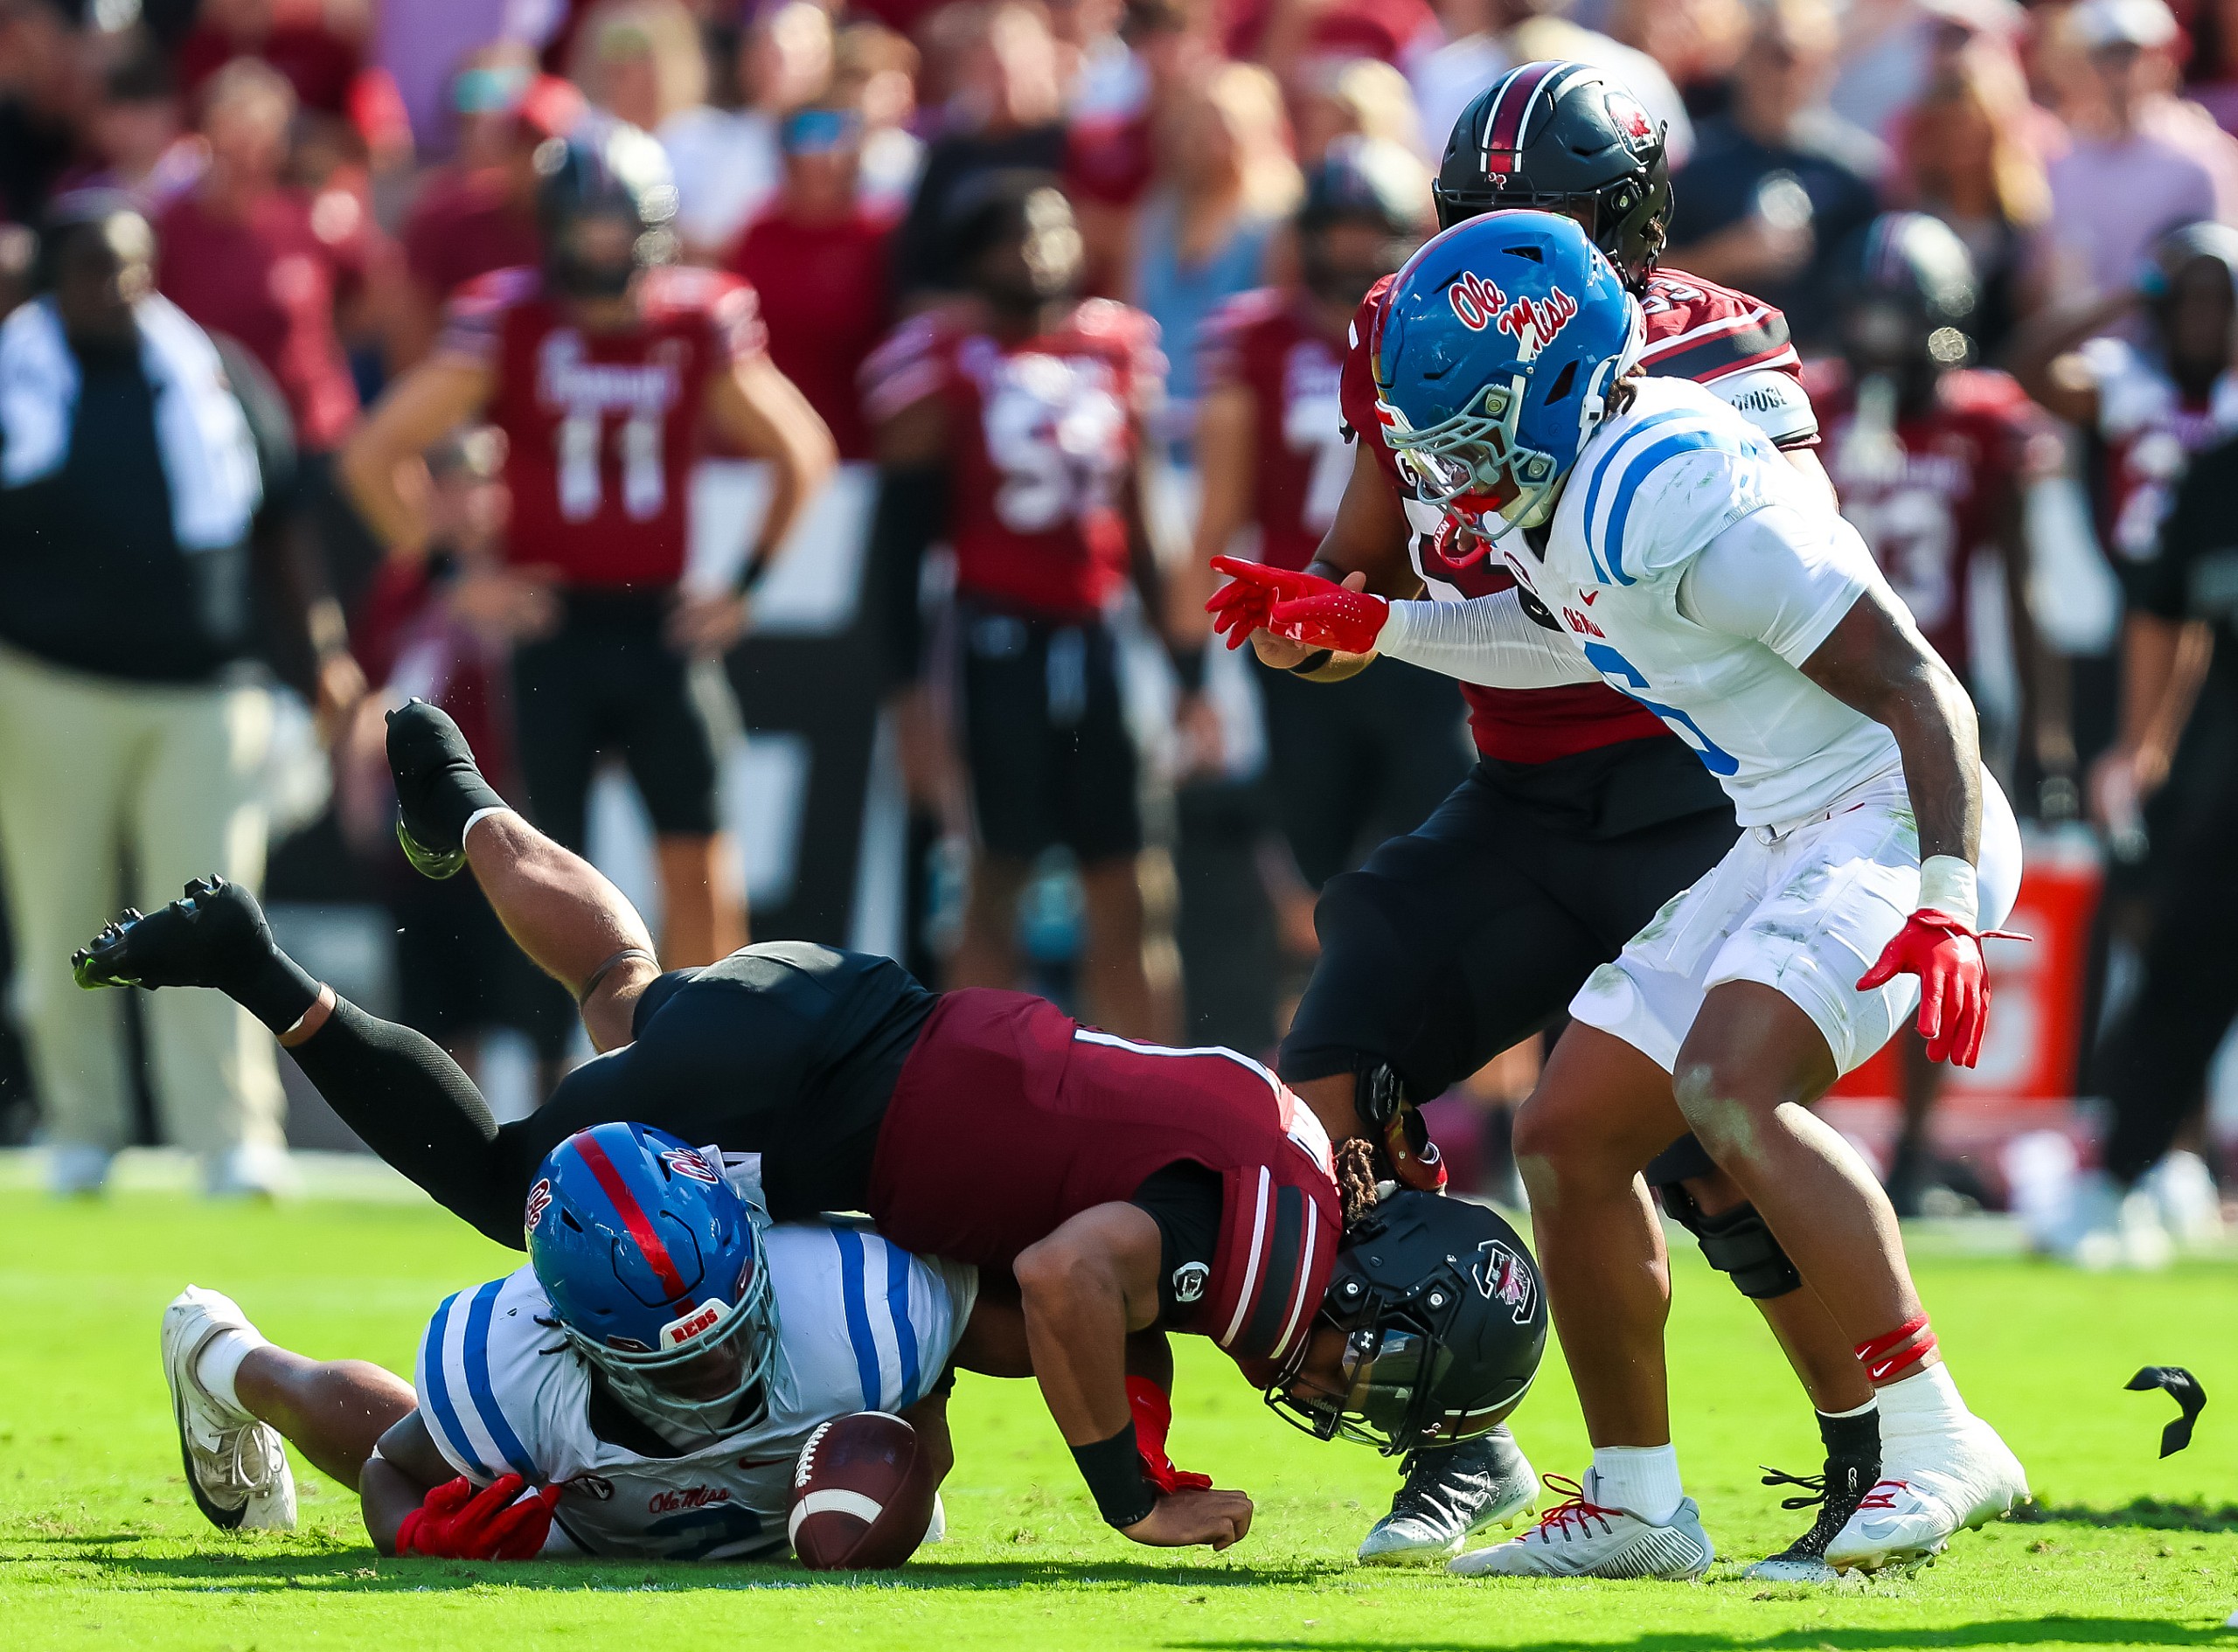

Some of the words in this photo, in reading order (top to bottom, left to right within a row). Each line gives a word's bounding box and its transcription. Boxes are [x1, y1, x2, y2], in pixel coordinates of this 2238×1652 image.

[1449, 271, 1507, 331] Ole
[1497, 286, 1578, 359] Miss
[557, 411, 666, 522] 11
[661, 1148, 719, 1183] Ole
[670, 1308, 719, 1343] REBS
[649, 1489, 679, 1514] Ole
[678, 1484, 731, 1508] Miss
